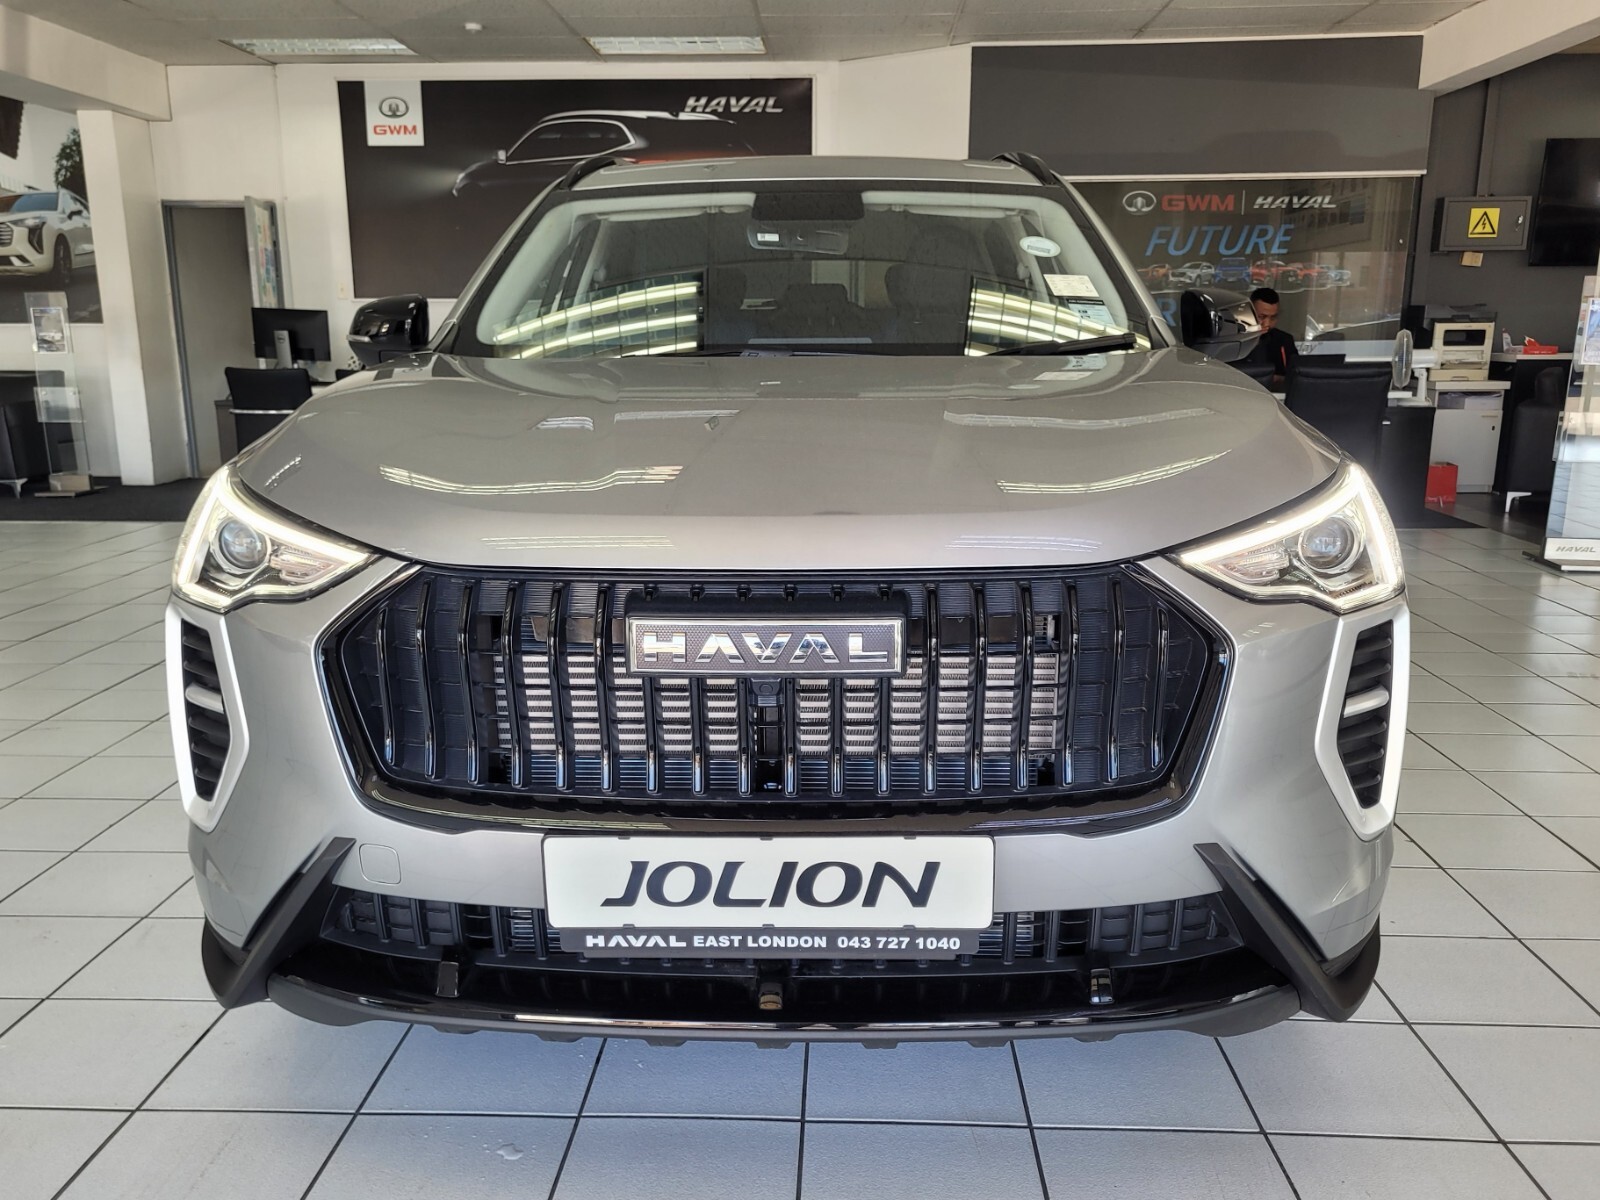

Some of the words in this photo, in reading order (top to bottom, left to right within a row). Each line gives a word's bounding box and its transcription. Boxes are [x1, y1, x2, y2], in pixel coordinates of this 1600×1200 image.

[684, 96, 783, 113] HAVAL
[373, 125, 417, 135] GWM
[1161, 194, 1235, 212] GWM
[1253, 195, 1337, 209] HAVAL
[1145, 224, 1294, 256] FUTURE
[643, 632, 888, 664] HAVAL
[600, 860, 941, 908] JOLION
[585, 935, 687, 947] HAVAL
[693, 935, 742, 947] EAST
[747, 935, 827, 948] LONDON
[837, 936, 871, 948] 043
[876, 937, 910, 949] 727
[915, 937, 961, 950] 1040
